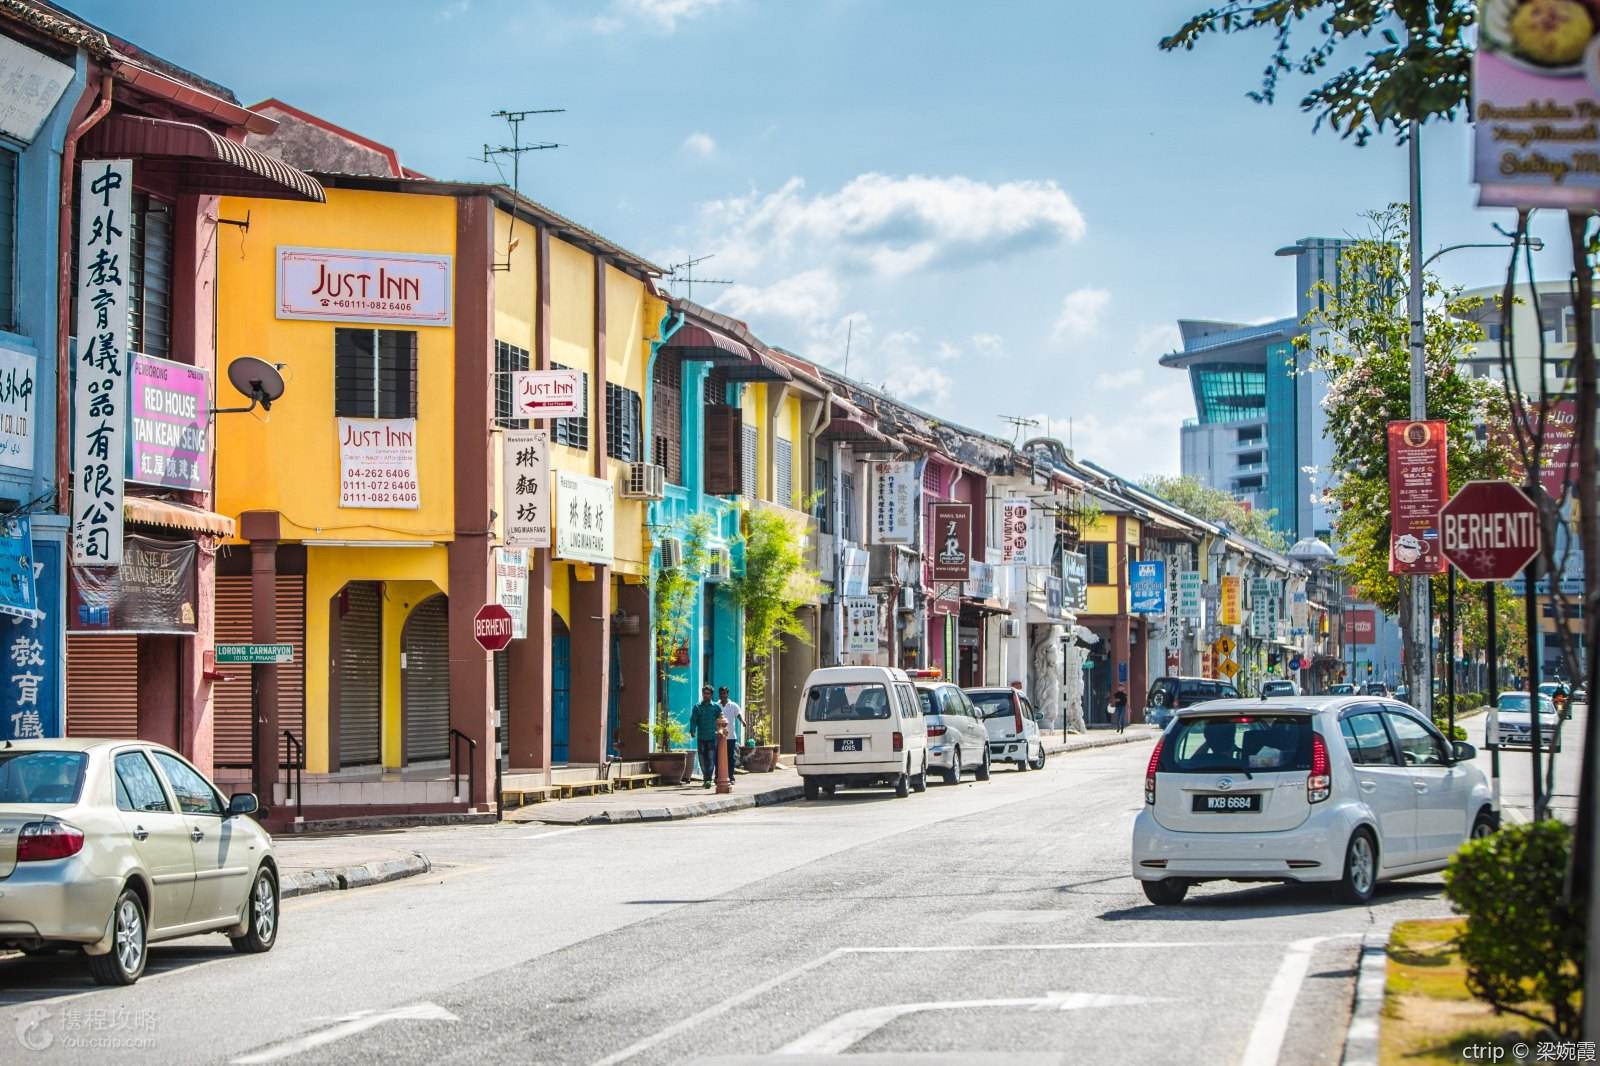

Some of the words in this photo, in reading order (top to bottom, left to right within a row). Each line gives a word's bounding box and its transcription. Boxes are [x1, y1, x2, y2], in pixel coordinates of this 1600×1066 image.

[312, 264, 371, 297] JUST
[380, 268, 419, 300] INN
[333, 301, 387, 310] +60111-082
[389, 302, 412, 311] 6406
[522, 380, 551, 396] JUST
[554, 379, 574, 395] INN
[144, 387, 163, 412] RED
[165, 391, 196, 418] HOUSE
[134, 418, 153, 442] TAN
[155, 421, 180, 447] KEAN
[182, 426, 205, 452] SENG
[344, 424, 381, 447] JUST
[386, 425, 413, 447] INN
[348, 469, 383, 478] 04-262
[386, 469, 410, 478] 6406
[344, 481, 389, 490] 0111-072
[391, 481, 416, 490] 6406
[344, 493, 390, 502] 0111-082
[392, 493, 417, 502] 6406
[534, 526, 546, 534] FANG
[1004, 505, 1013, 542] VINTAGE
[1444, 512, 1534, 550] BERHENTI
[476, 618, 511, 636] BERHENTI
[218, 646, 247, 655] LORONG
[249, 646, 291, 655] CARNARVON
[1207, 797, 1226, 808] WXB
[1227, 797, 1251, 808] 6684
